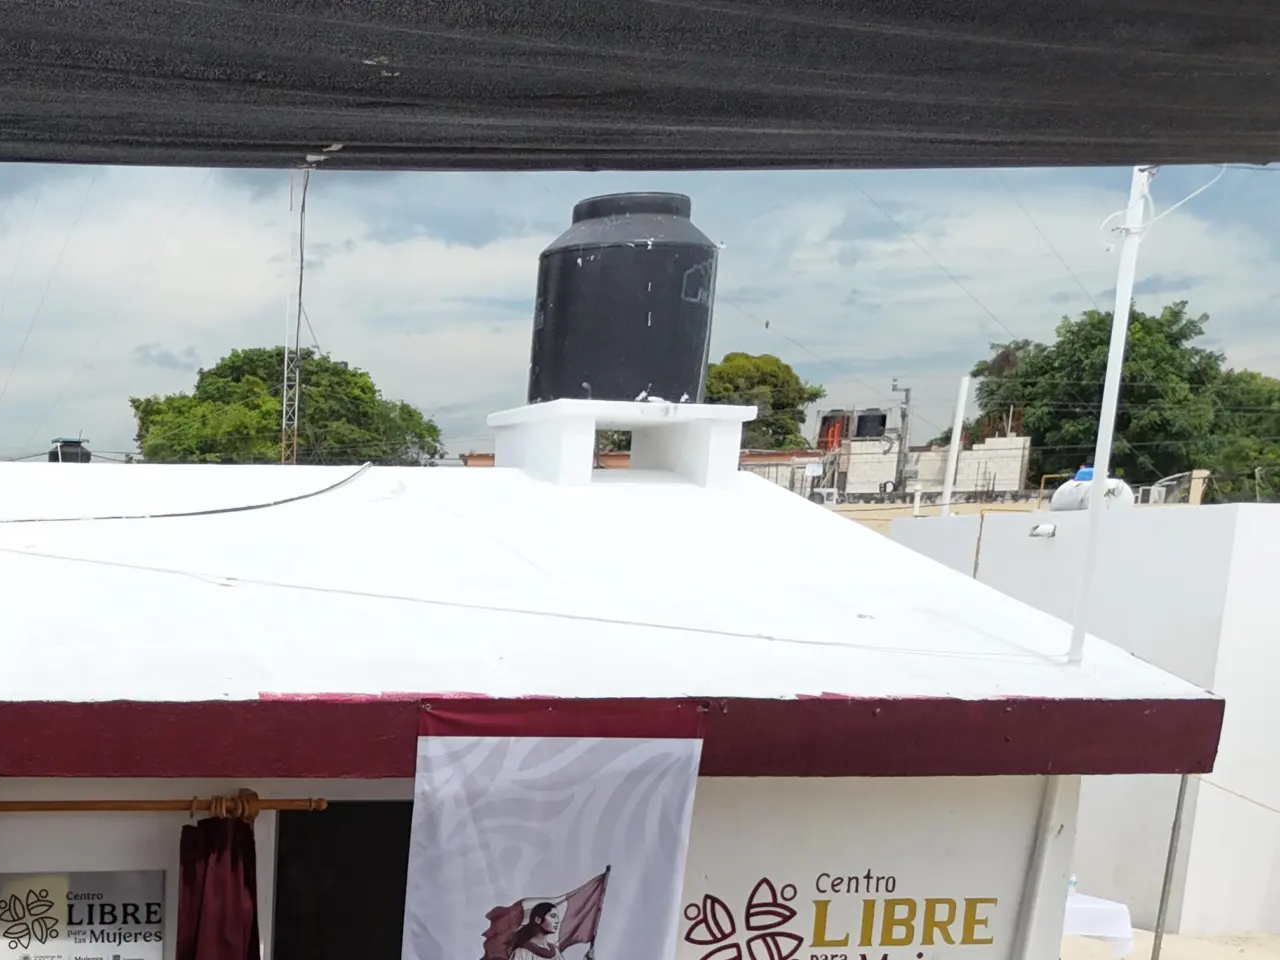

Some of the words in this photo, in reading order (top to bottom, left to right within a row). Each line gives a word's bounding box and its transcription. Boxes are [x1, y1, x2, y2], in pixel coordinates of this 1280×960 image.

[816, 868, 896, 894] Centro
[66, 891, 104, 900] Centro
[66, 903, 162, 926] LIBRE
[809, 897, 998, 948] LIBRE
[67, 930, 87, 938] para
[74, 936, 87, 944] las
[89, 928, 163, 947] Mujeres
